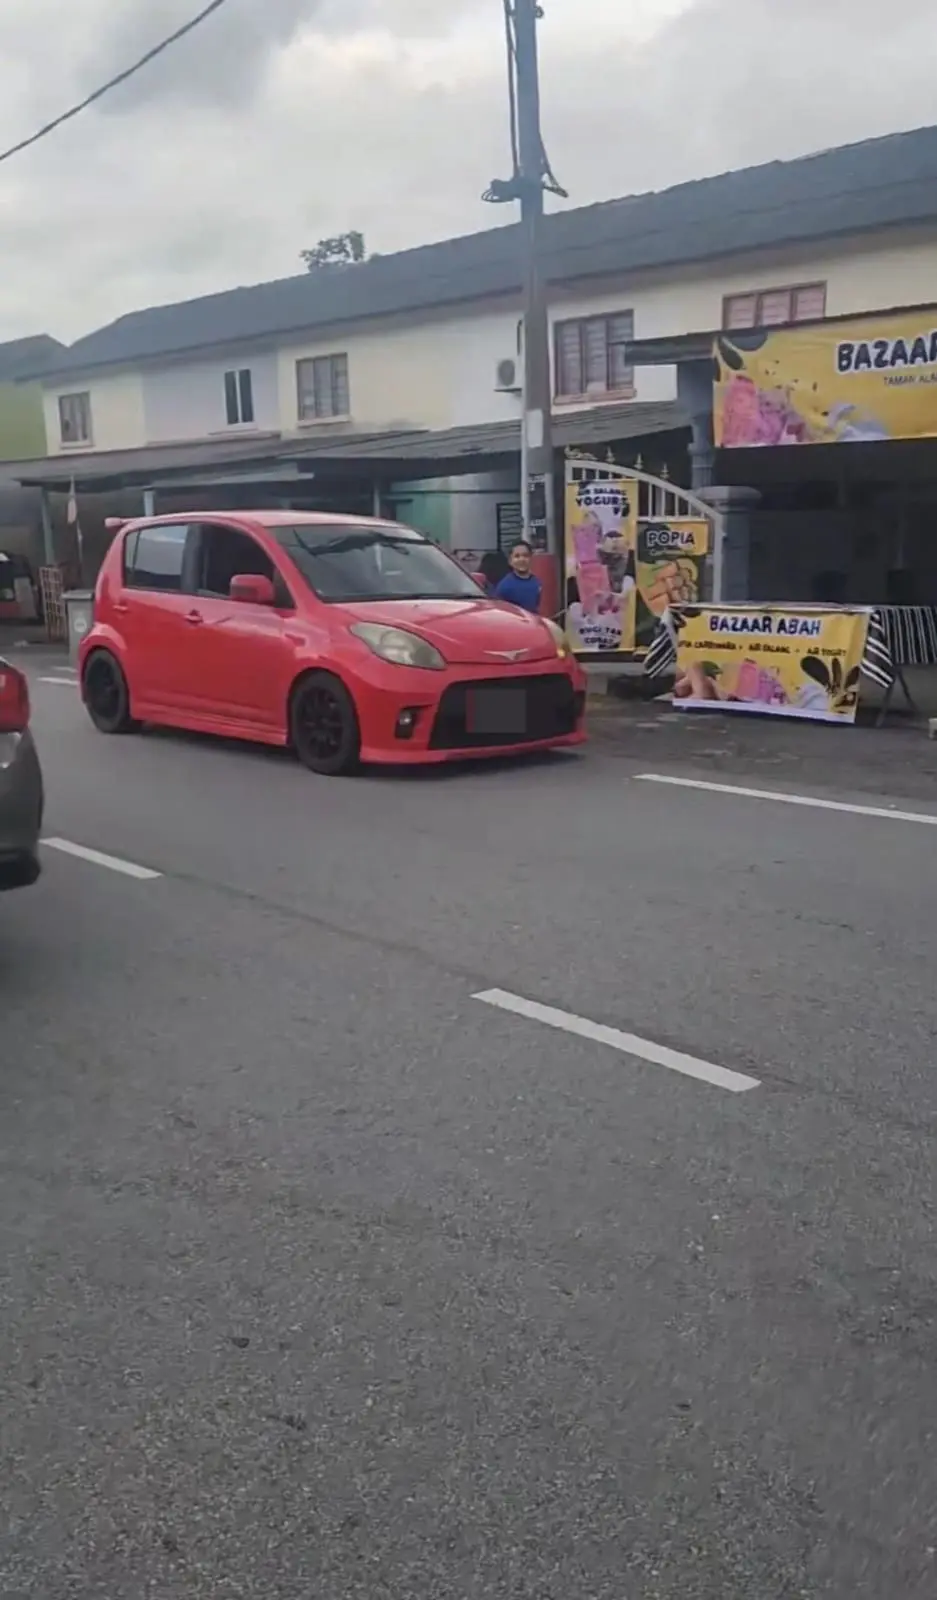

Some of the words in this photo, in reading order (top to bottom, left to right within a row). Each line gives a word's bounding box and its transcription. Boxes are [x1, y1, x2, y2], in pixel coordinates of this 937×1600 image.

[575, 496, 628, 507] YOGURT
[648, 531, 696, 546] POPIA
[710, 615, 772, 634] BAZAAR
[776, 618, 821, 635] ABAH
